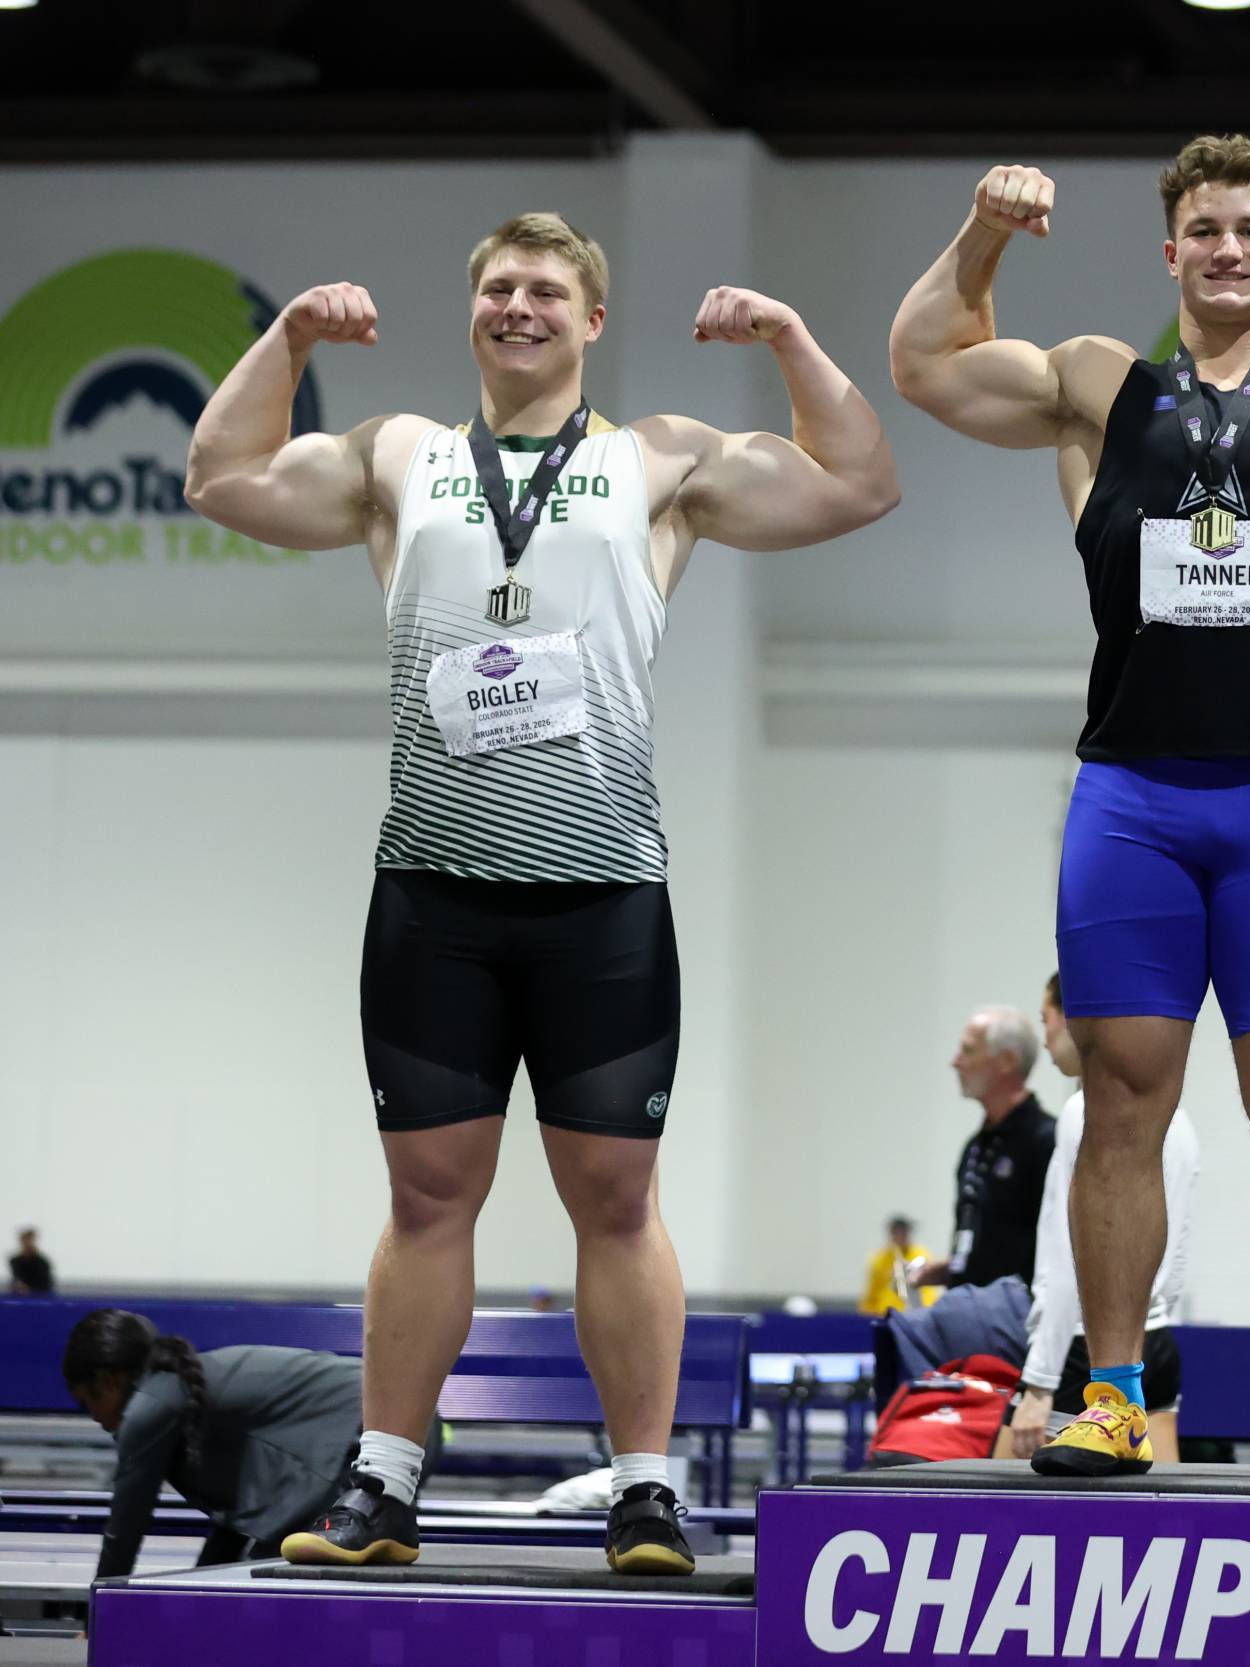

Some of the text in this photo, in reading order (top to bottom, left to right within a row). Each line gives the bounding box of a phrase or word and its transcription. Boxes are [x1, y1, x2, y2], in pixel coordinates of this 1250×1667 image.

[0, 454, 196, 516] enoTa
[0, 521, 147, 565] DOOR
[1213, 590, 1235, 598] FORCE
[1174, 606, 1212, 614] FEBRUARY
[1213, 606, 1223, 614] 26
[1228, 606, 1240, 615] 28,
[1216, 616, 1244, 624] NEVADA
[466, 679, 539, 711] BIGLEY
[478, 705, 534, 721] COLORADO STATE
[505, 725, 515, 734] 26
[533, 718, 551, 729] 2026
[509, 732, 539, 743] NEVADA
